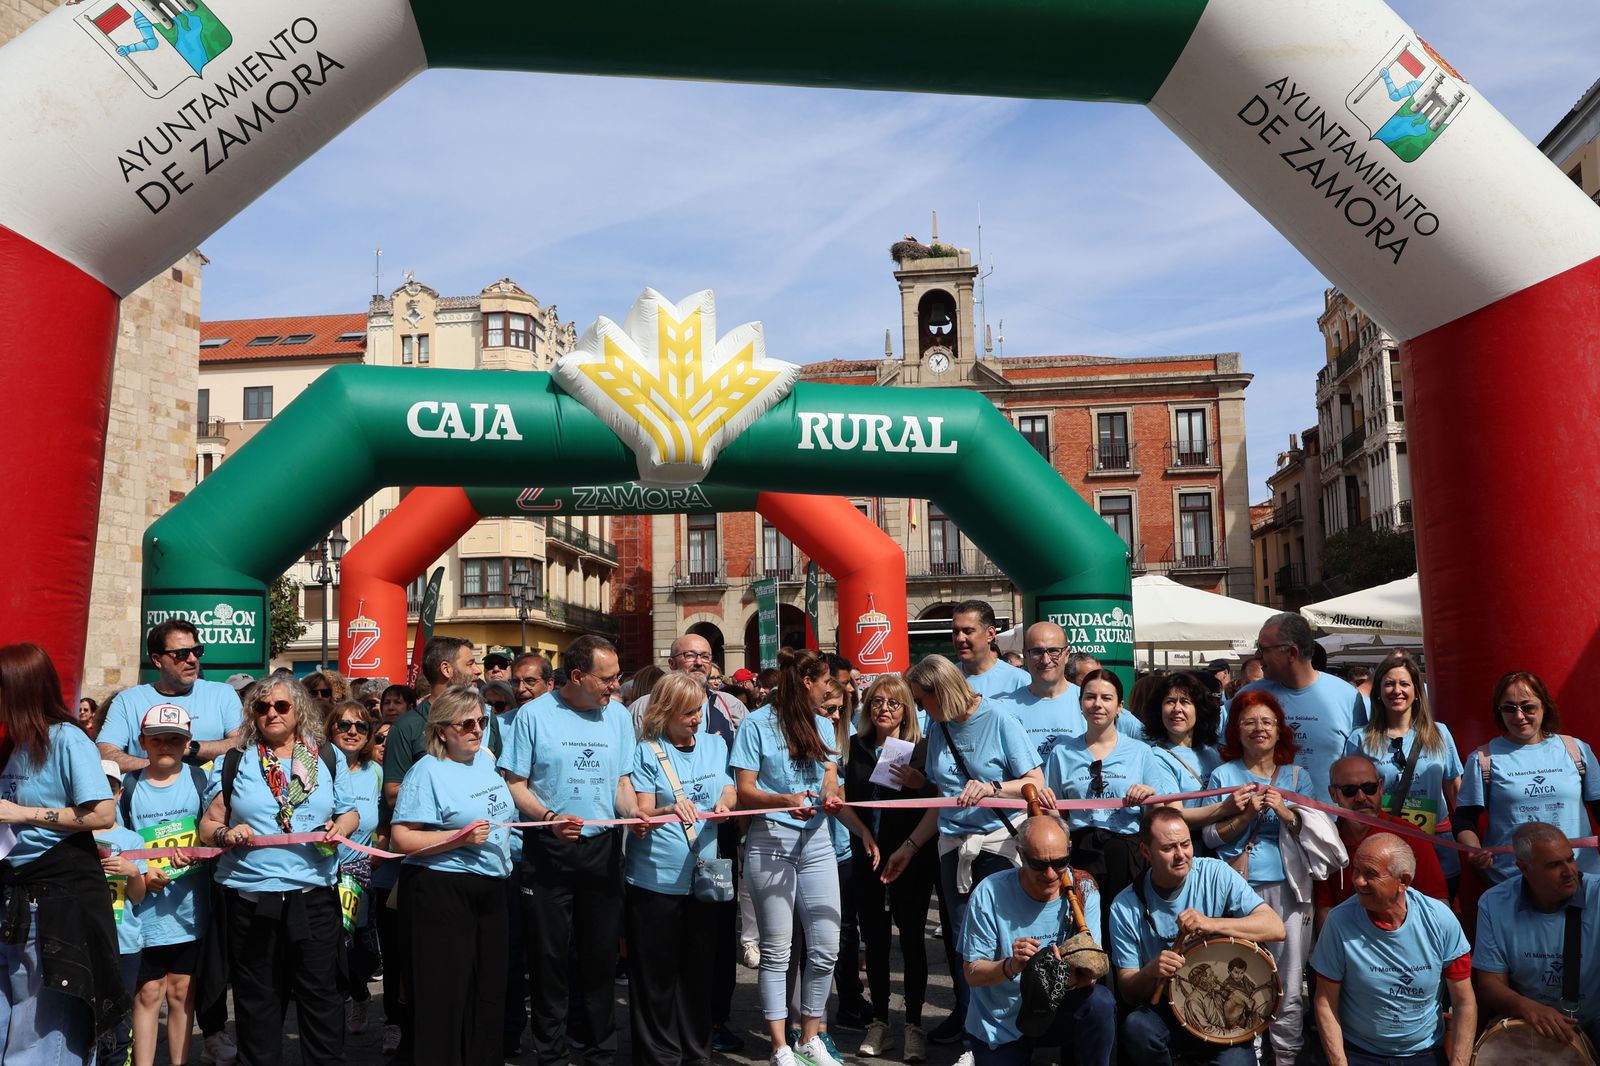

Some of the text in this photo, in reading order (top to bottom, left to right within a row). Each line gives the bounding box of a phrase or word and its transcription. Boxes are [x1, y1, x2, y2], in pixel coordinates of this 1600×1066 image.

[117, 16, 318, 183] AYUNTAMIENTO
[135, 50, 345, 215] DE ZAMORA
[1264, 76, 1440, 237] AYUNTAMIENTO
[1237, 94, 1410, 265] DE ZAMORA
[406, 400, 958, 454] CAJA RURAL
[572, 482, 712, 511] ZAMORA
[1330, 614, 1383, 628] Alhambra
[197, 628, 256, 644] RURAL
[1095, 629, 1133, 644] RURAL
[1069, 645, 1106, 653] AMORA
[1037, 741, 1054, 755] AZAY
[574, 757, 600, 770] AZAYCA
[696, 773, 716, 781] Solidaria
[1524, 784, 1556, 797] AZAYCA
[164, 808, 188, 816] Solidaria
[487, 801, 508, 816] AZAYCA
[1389, 983, 1425, 998] AZAYCA
